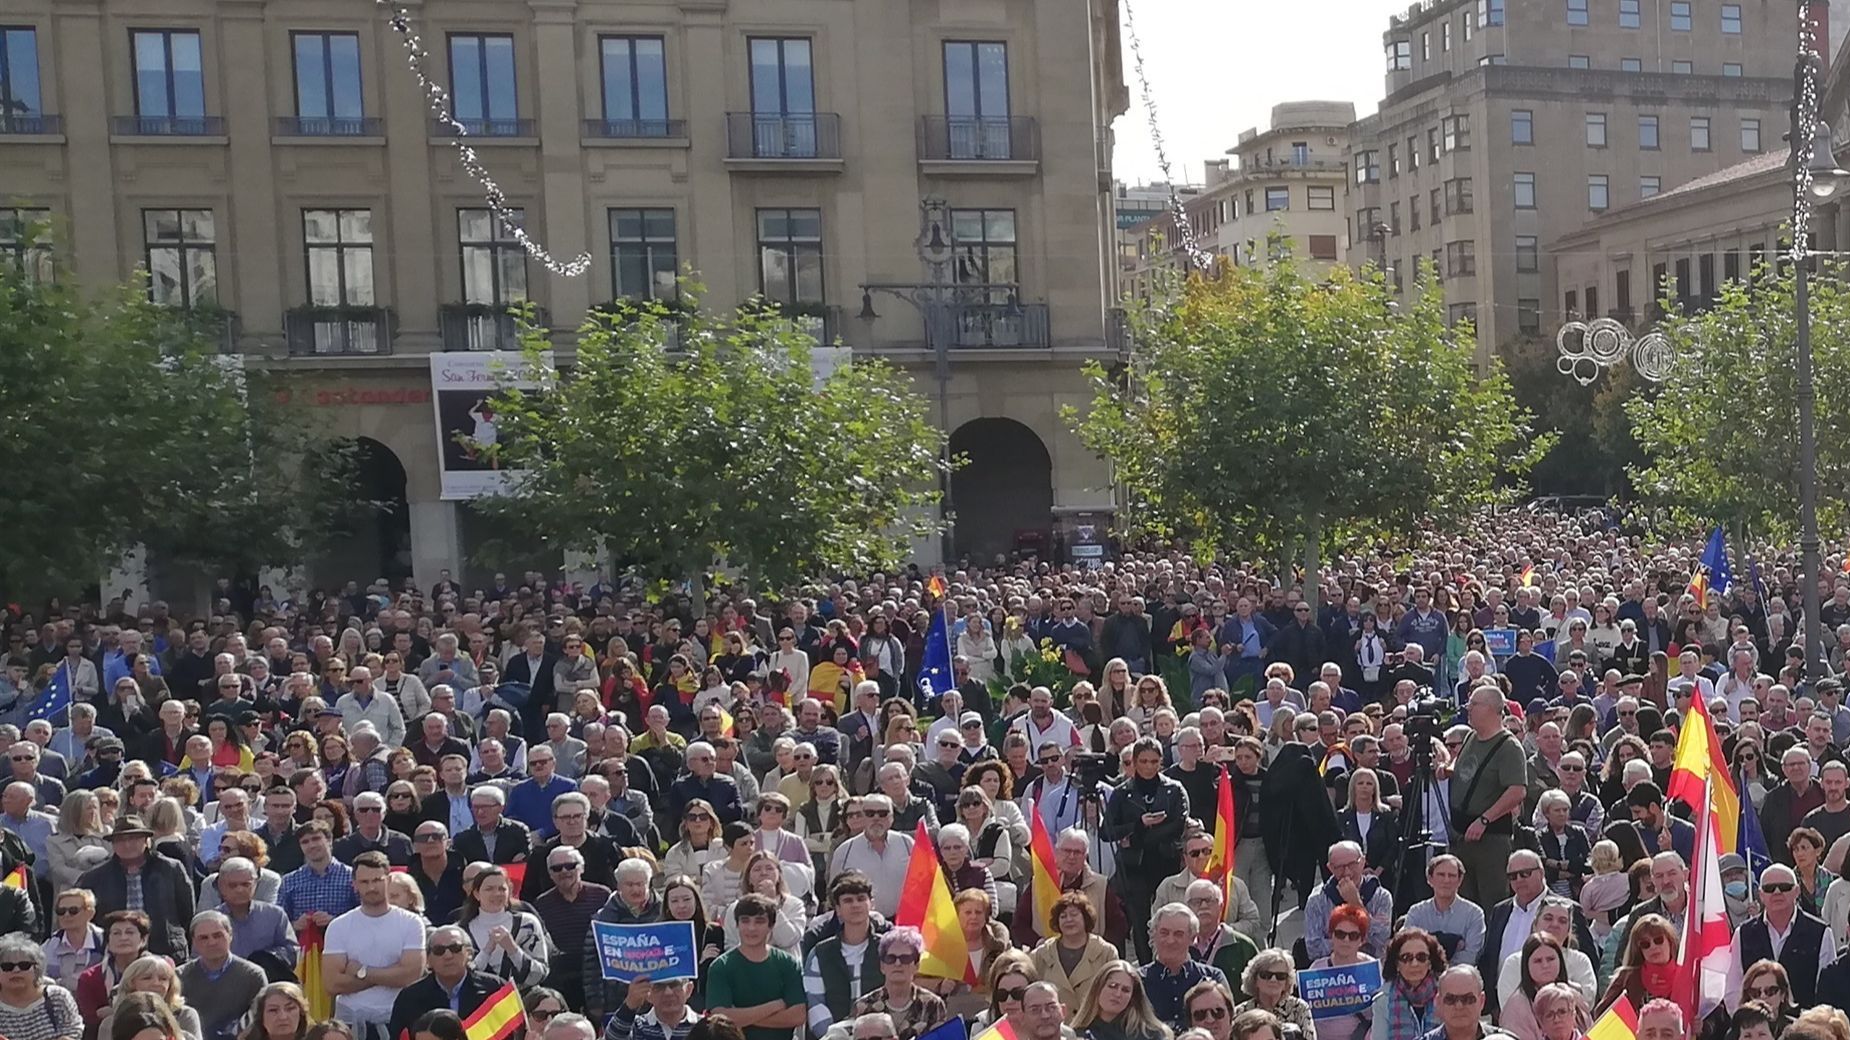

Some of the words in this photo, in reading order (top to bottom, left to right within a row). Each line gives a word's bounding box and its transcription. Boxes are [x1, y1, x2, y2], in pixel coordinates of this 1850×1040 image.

[602, 933, 660, 947] ESPAÑA
[604, 945, 622, 958] EN
[606, 957, 680, 973] IGUALDAD
[1306, 973, 1356, 989] ESPAÑA
[1307, 989, 1324, 999] EN
[1309, 994, 1371, 1009] IGUALDAD
